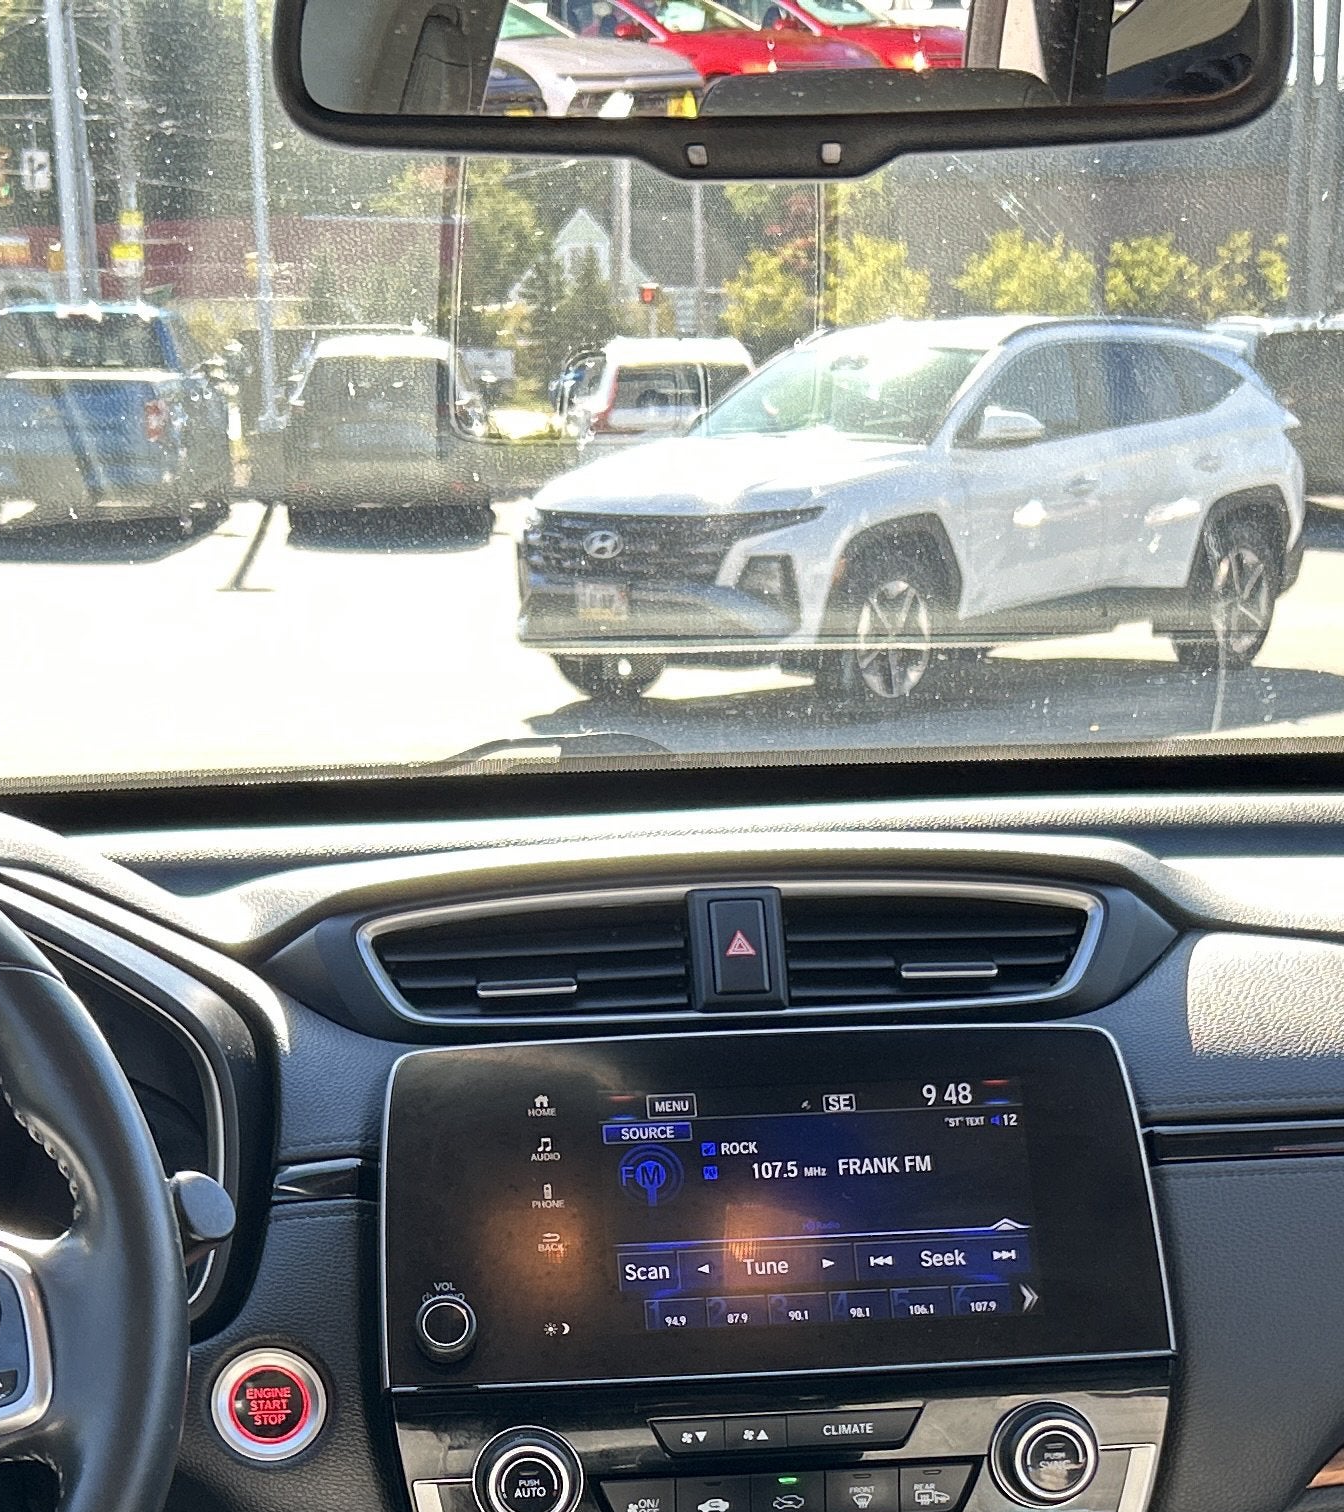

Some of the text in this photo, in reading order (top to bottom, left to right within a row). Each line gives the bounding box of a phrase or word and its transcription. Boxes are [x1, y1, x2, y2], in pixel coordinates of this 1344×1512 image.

[655, 1100, 690, 1113] MENU
[827, 1095, 852, 1111] SE
[527, 1108, 556, 1117] HOME
[965, 1116, 985, 1126] TEXT
[1002, 1113, 1018, 1126] 12
[621, 1126, 675, 1140] SOURCE
[721, 1141, 758, 1155] ROCK
[530, 1152, 561, 1162] AUDIO
[752, 1155, 932, 1179] 107.5 MHz FRANK FM
[531, 1200, 565, 1209] PHONE
[538, 1243, 564, 1252] BACK
[920, 1249, 967, 1268] Seek
[625, 1263, 670, 1281] Scan
[743, 1258, 789, 1275] Tune
[433, 1282, 456, 1291] VOL
[970, 1300, 997, 1313] 107.9
[246, 1387, 292, 1399] ENGINE
[250, 1399, 289, 1411] START
[254, 1414, 286, 1426] STOP
[823, 1422, 874, 1436] CLIMATE
[518, 1479, 540, 1488] PUSH
[913, 1483, 936, 1491] REAR
[514, 1487, 546, 1499] AUTO
[849, 1486, 875, 1494] FRONT
